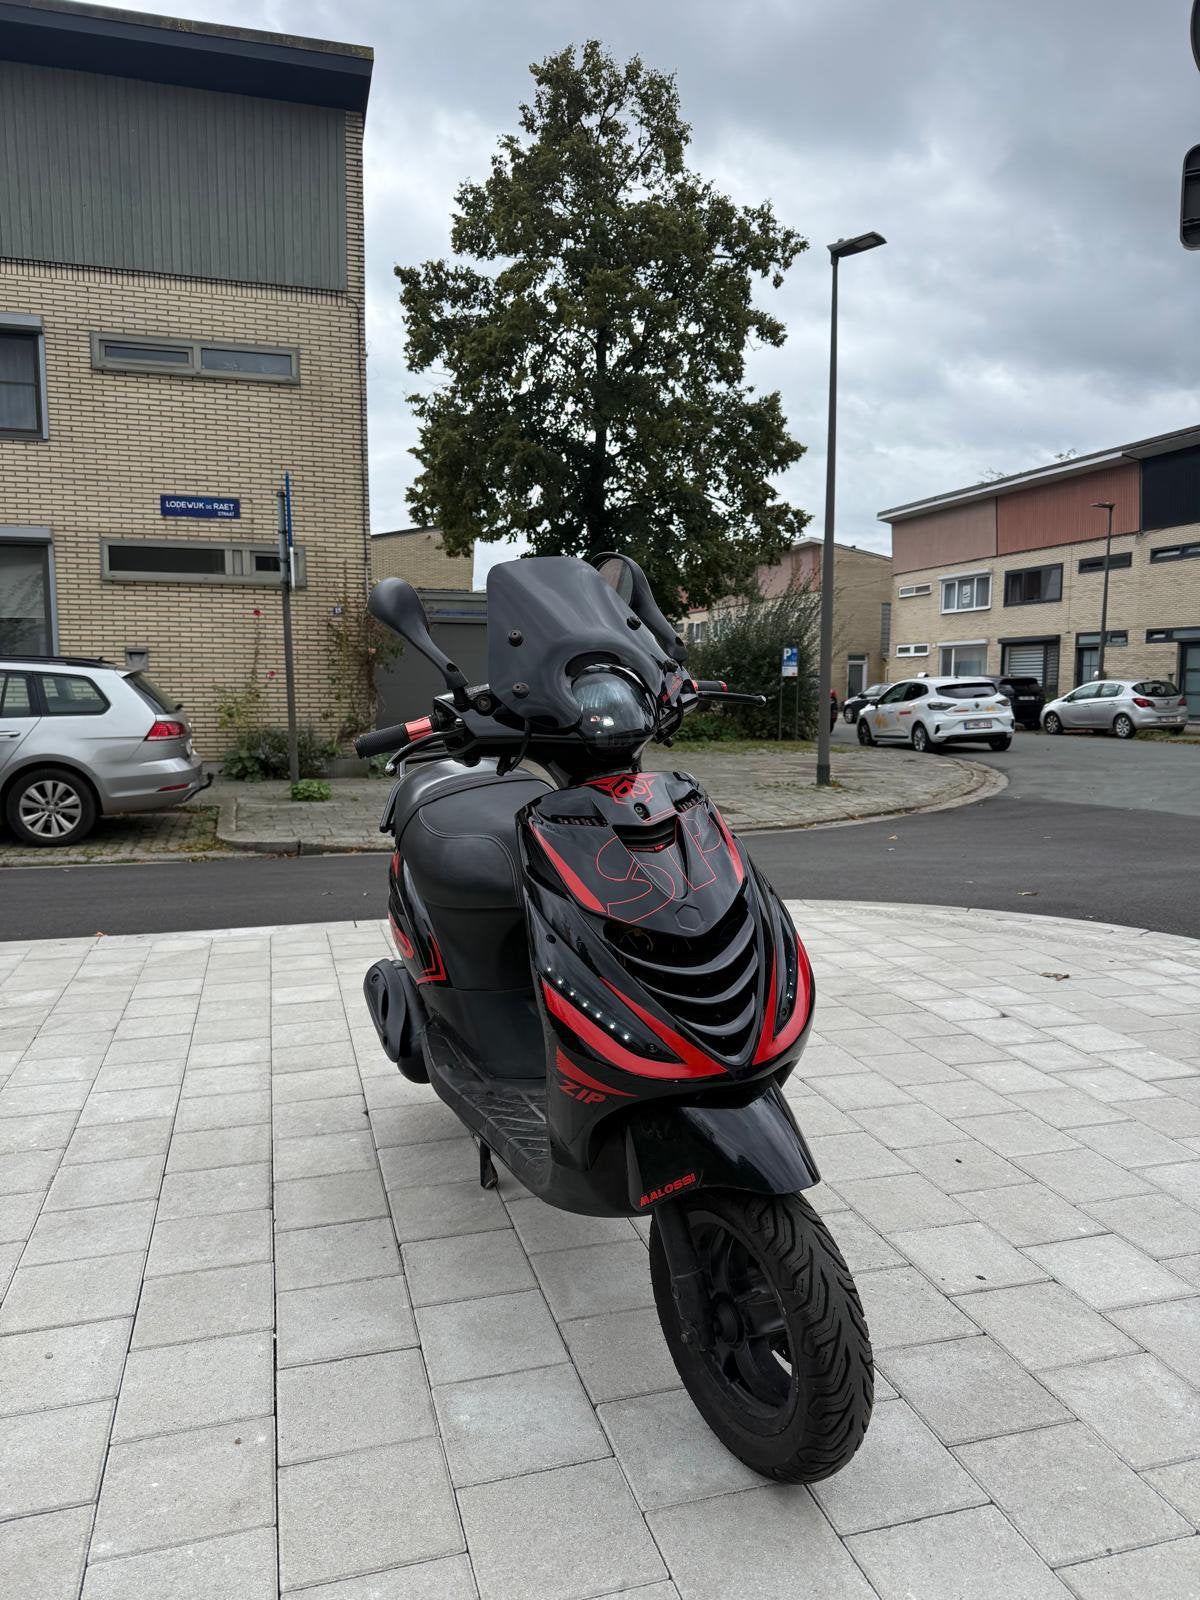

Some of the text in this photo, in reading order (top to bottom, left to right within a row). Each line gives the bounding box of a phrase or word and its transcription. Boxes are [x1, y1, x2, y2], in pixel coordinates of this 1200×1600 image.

[213, 502, 235, 510] RAET
[783, 647, 792, 660] P
[558, 1079, 606, 1105] ZIP
[640, 1172, 696, 1207] MALOSSI
